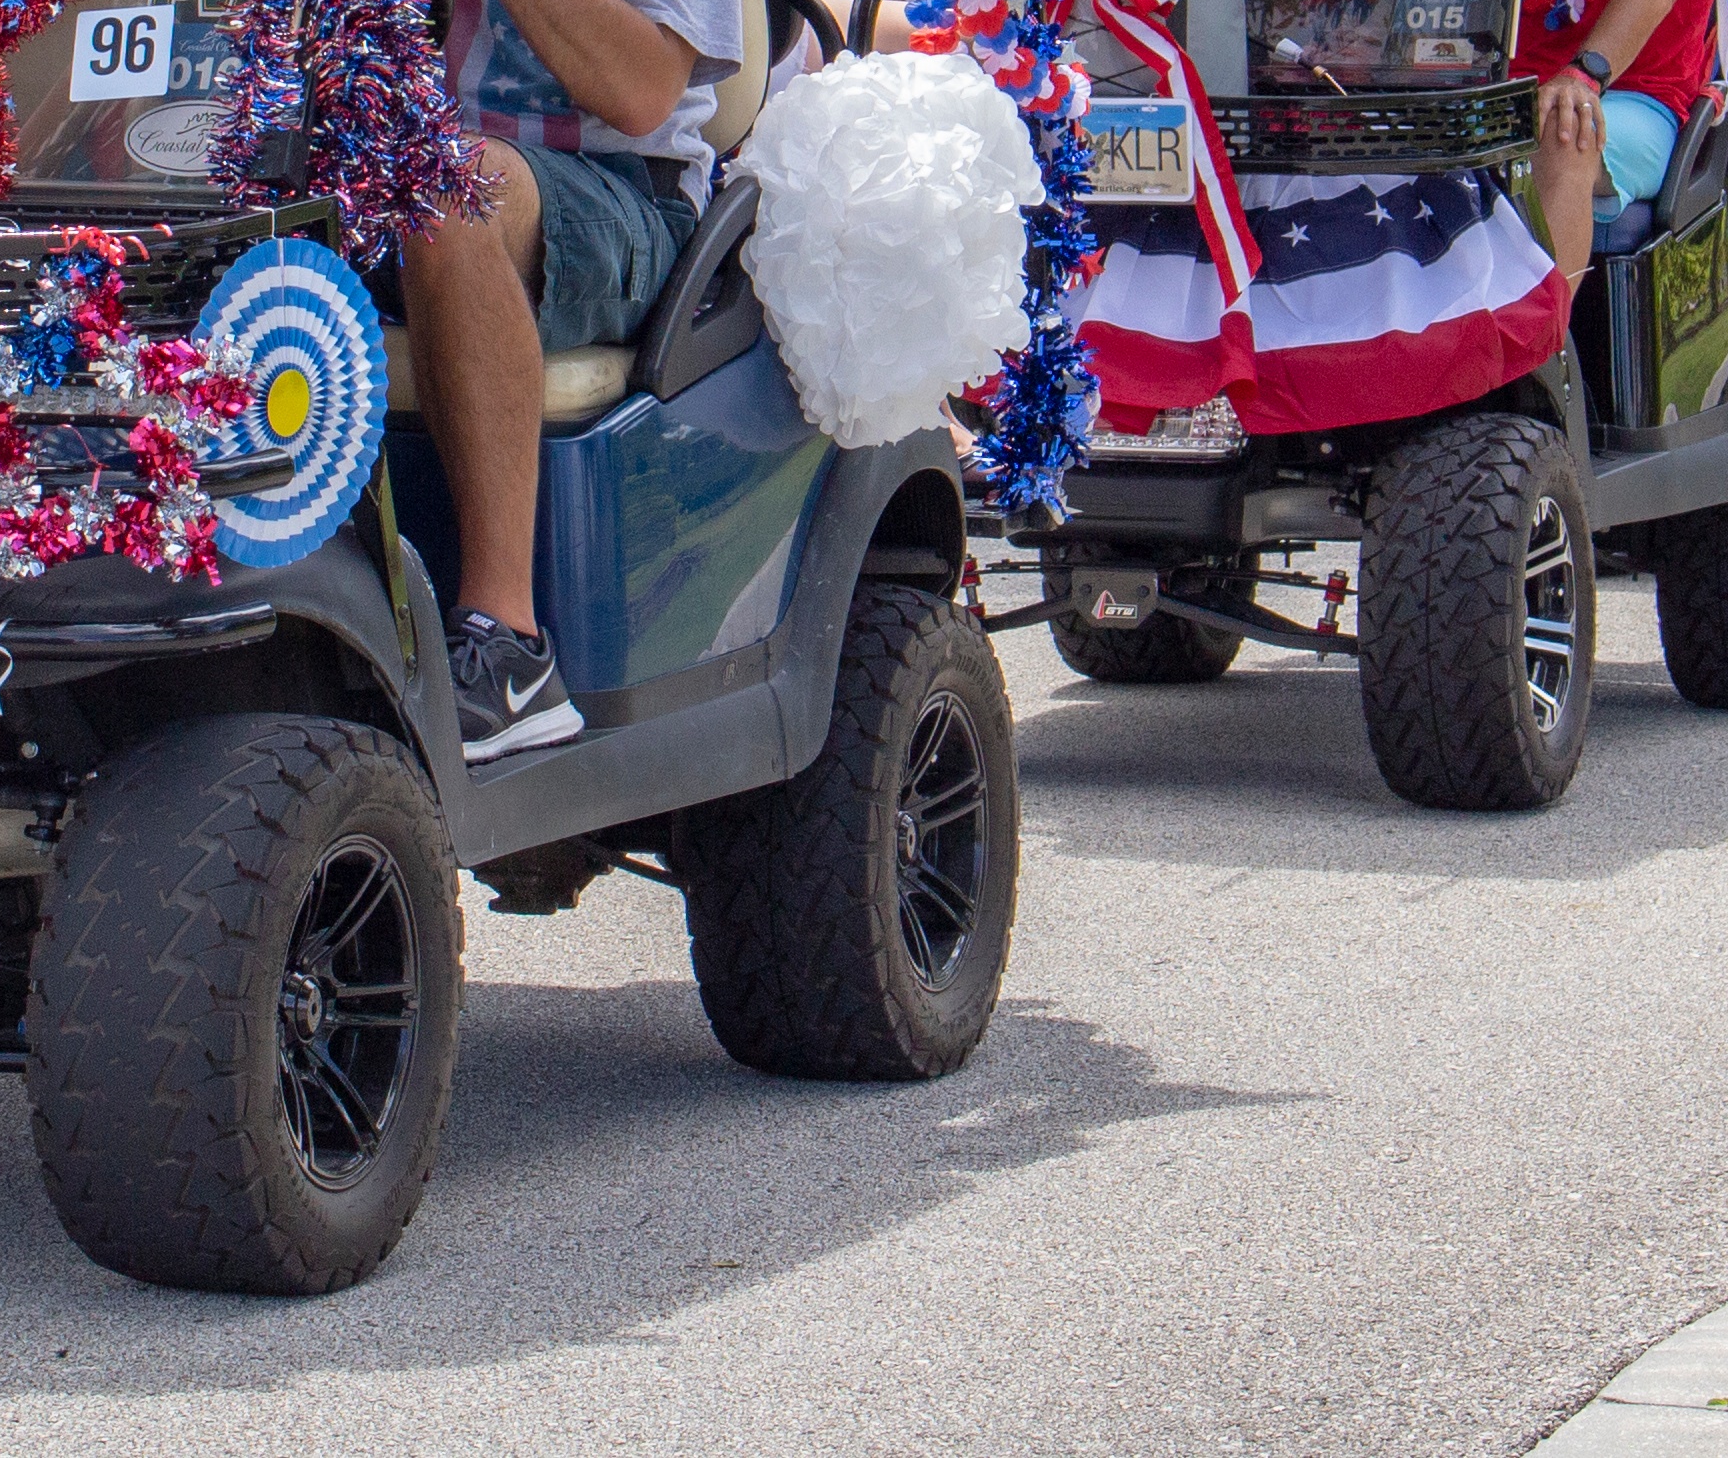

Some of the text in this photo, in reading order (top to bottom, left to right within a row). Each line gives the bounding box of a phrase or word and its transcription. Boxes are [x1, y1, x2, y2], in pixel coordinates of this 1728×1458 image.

[1406, 5, 1465, 30] 015
[89, 14, 158, 76] 96
[465, 613, 497, 630] NIKE
[1104, 606, 1135, 616] GTW
